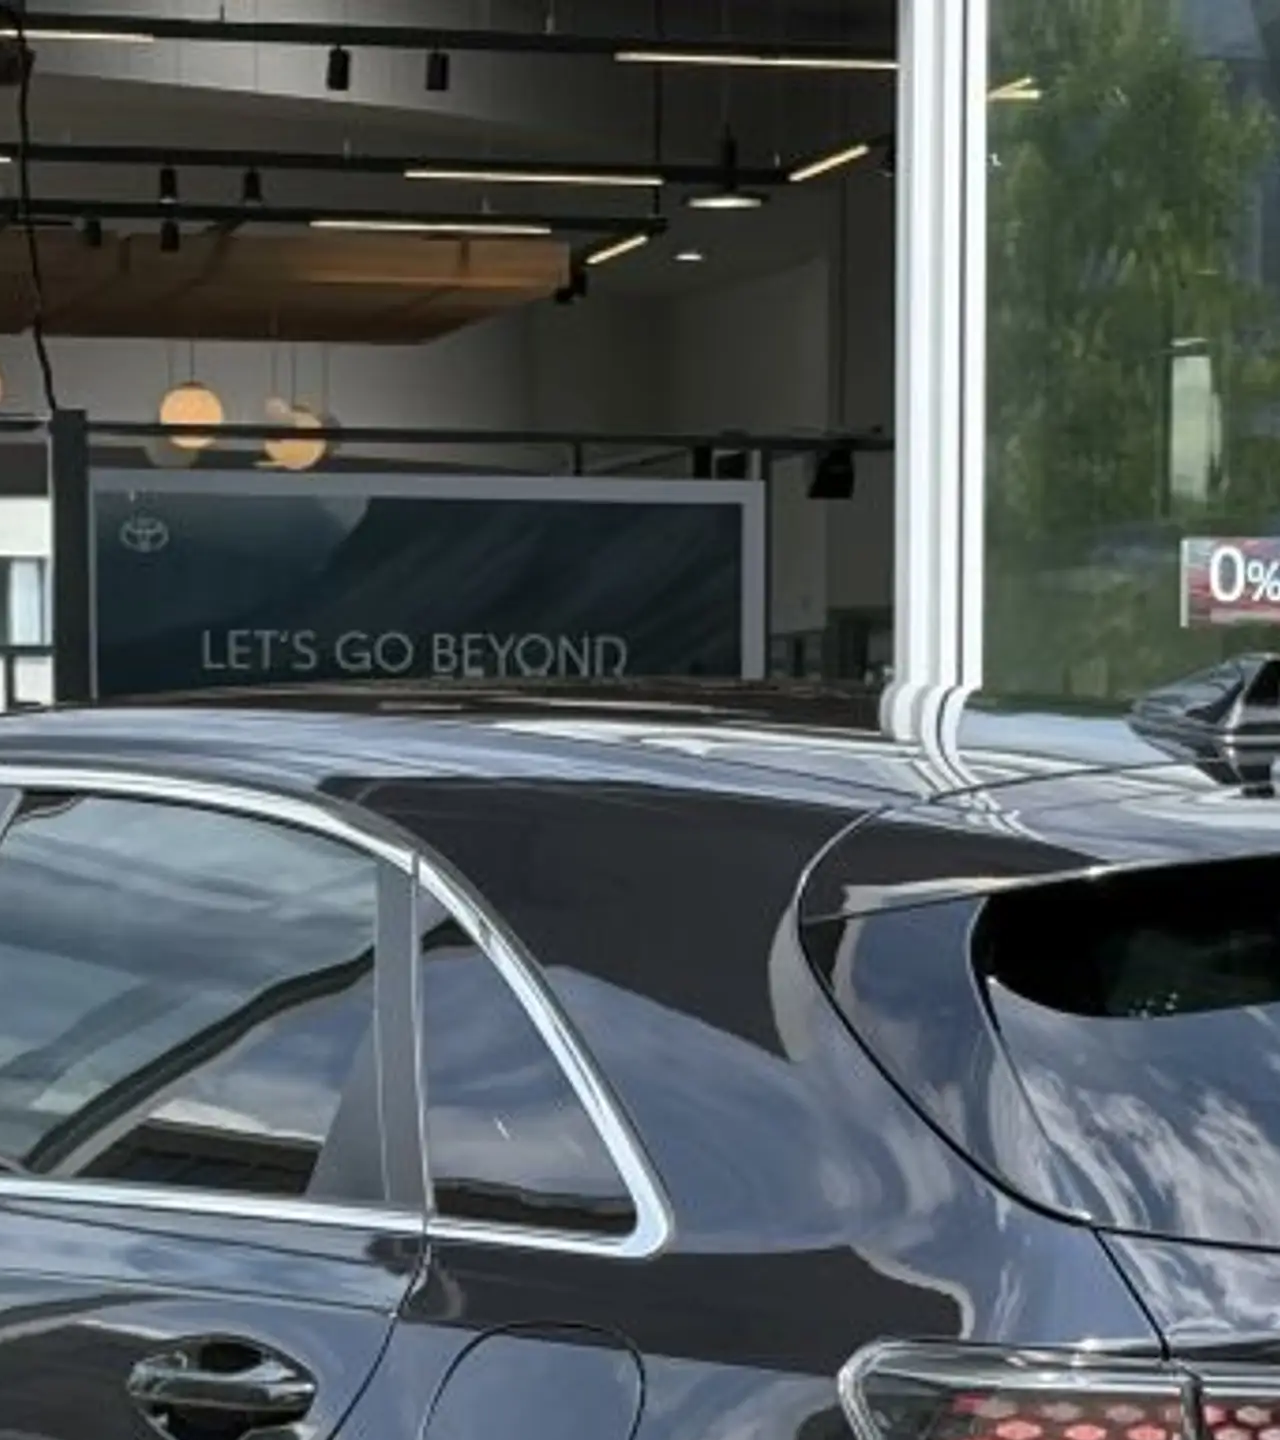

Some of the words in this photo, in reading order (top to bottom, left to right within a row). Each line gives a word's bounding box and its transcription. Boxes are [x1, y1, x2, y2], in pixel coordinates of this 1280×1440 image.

[202, 629, 317, 670] LET'S
[335, 630, 413, 672] GO
[432, 633, 627, 677] BEYOND
